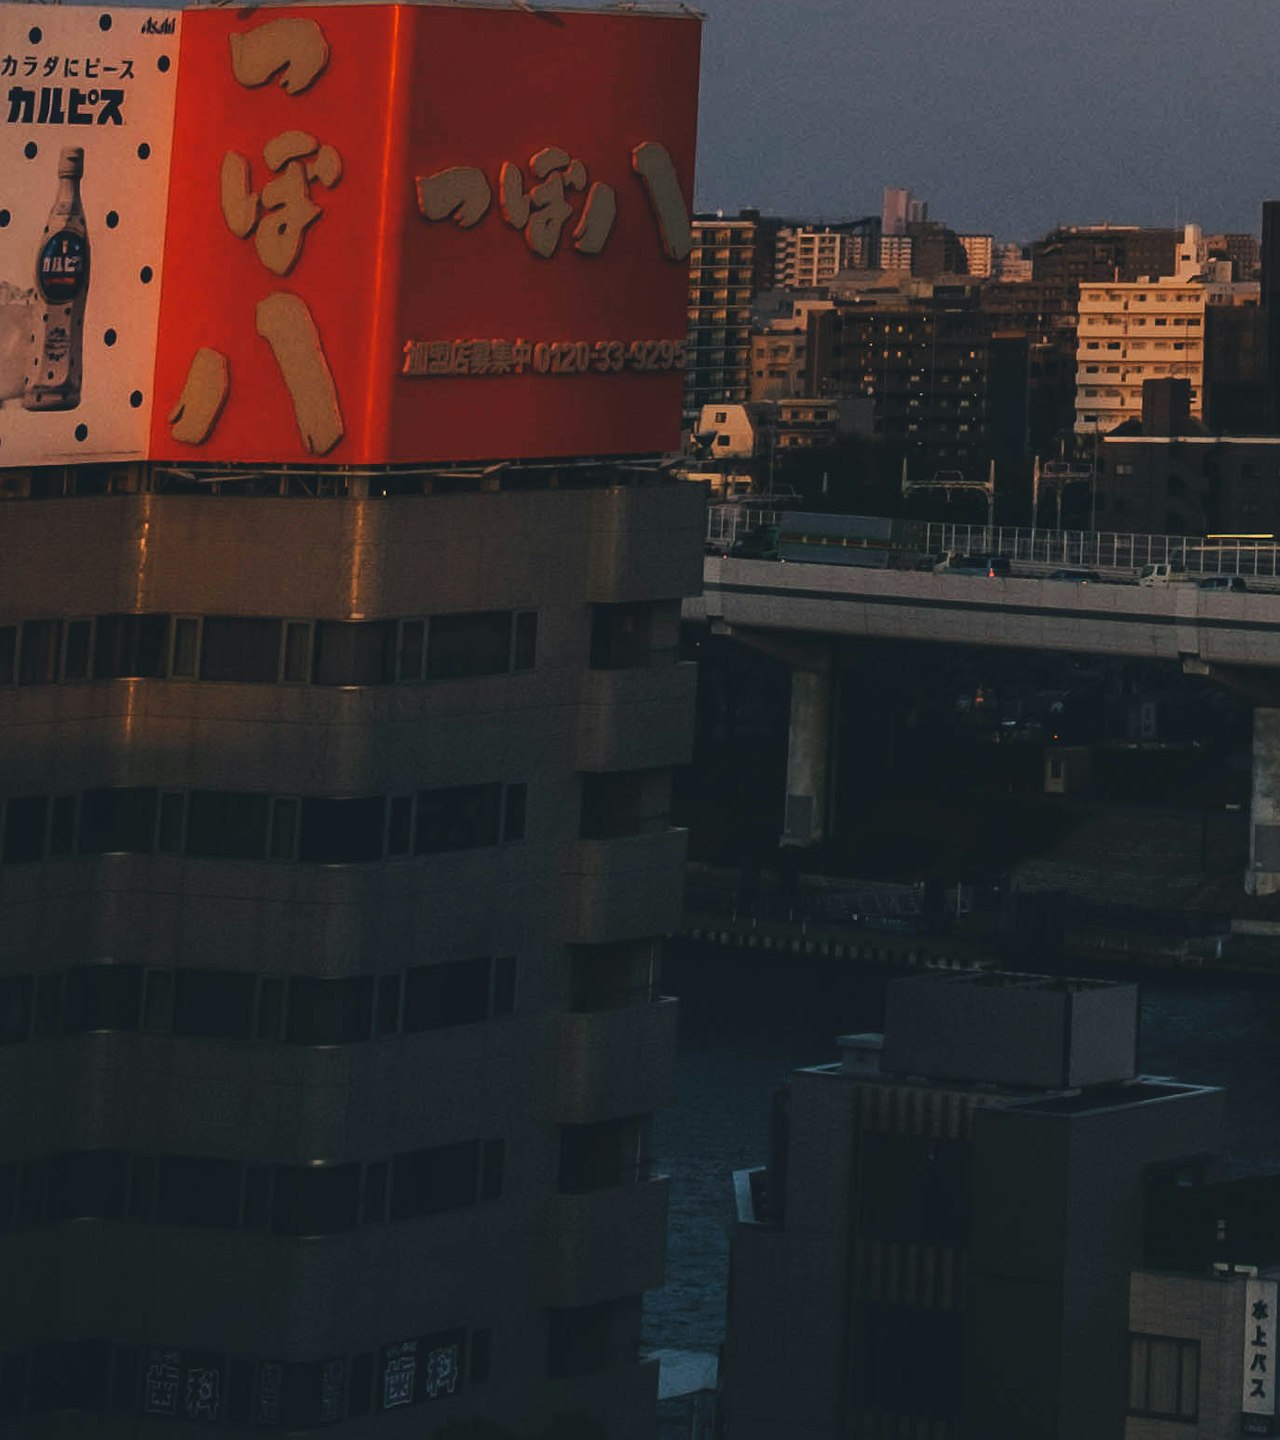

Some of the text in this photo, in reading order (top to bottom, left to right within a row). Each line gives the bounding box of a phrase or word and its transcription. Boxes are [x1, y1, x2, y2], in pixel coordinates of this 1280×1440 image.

[141, 16, 177, 35] Asahi
[7, 86, 126, 126] カルピス
[1250, 1299, 1269, 1399] 水上バス
